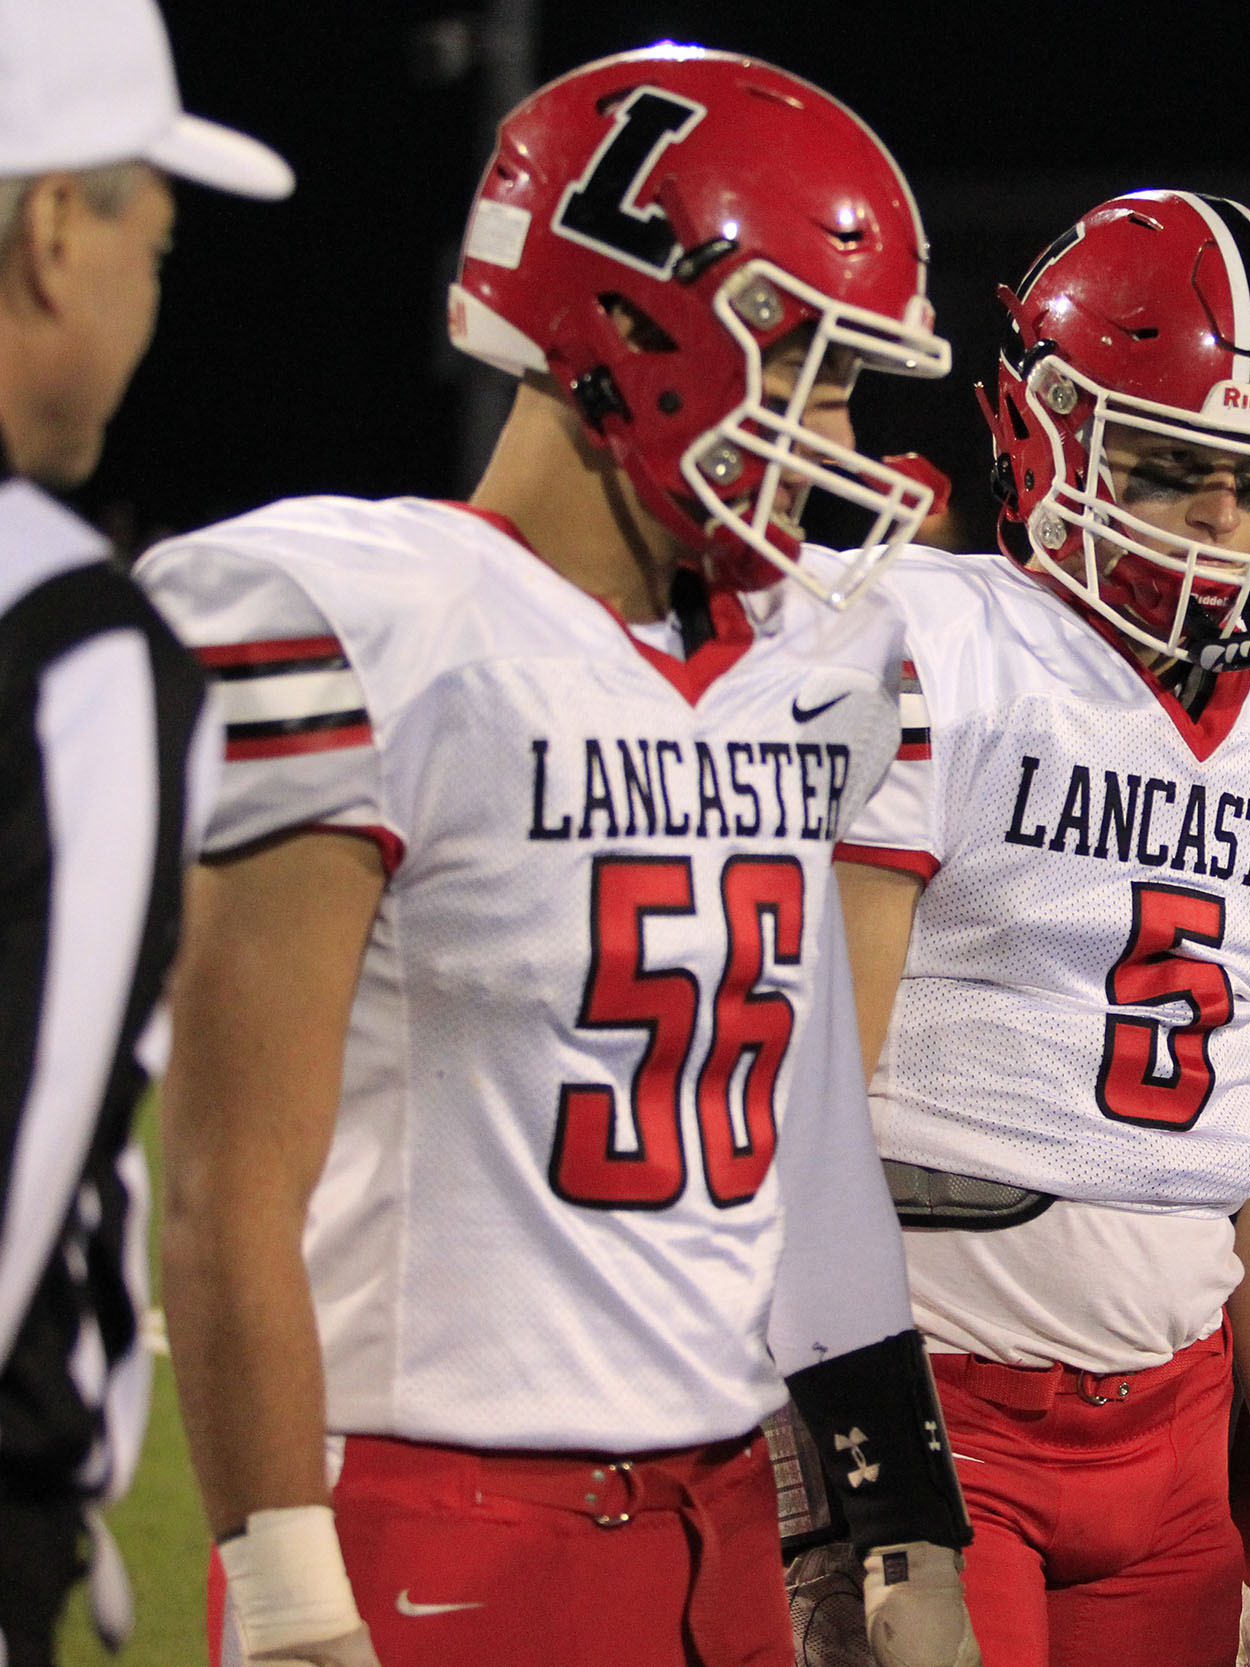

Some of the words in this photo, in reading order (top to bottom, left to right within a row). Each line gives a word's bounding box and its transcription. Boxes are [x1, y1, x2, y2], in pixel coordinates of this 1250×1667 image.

[551, 85, 708, 282] L
[529, 739, 849, 840] LANCASTER
[548, 853, 804, 1212] 56
[1095, 880, 1235, 1133] 5
